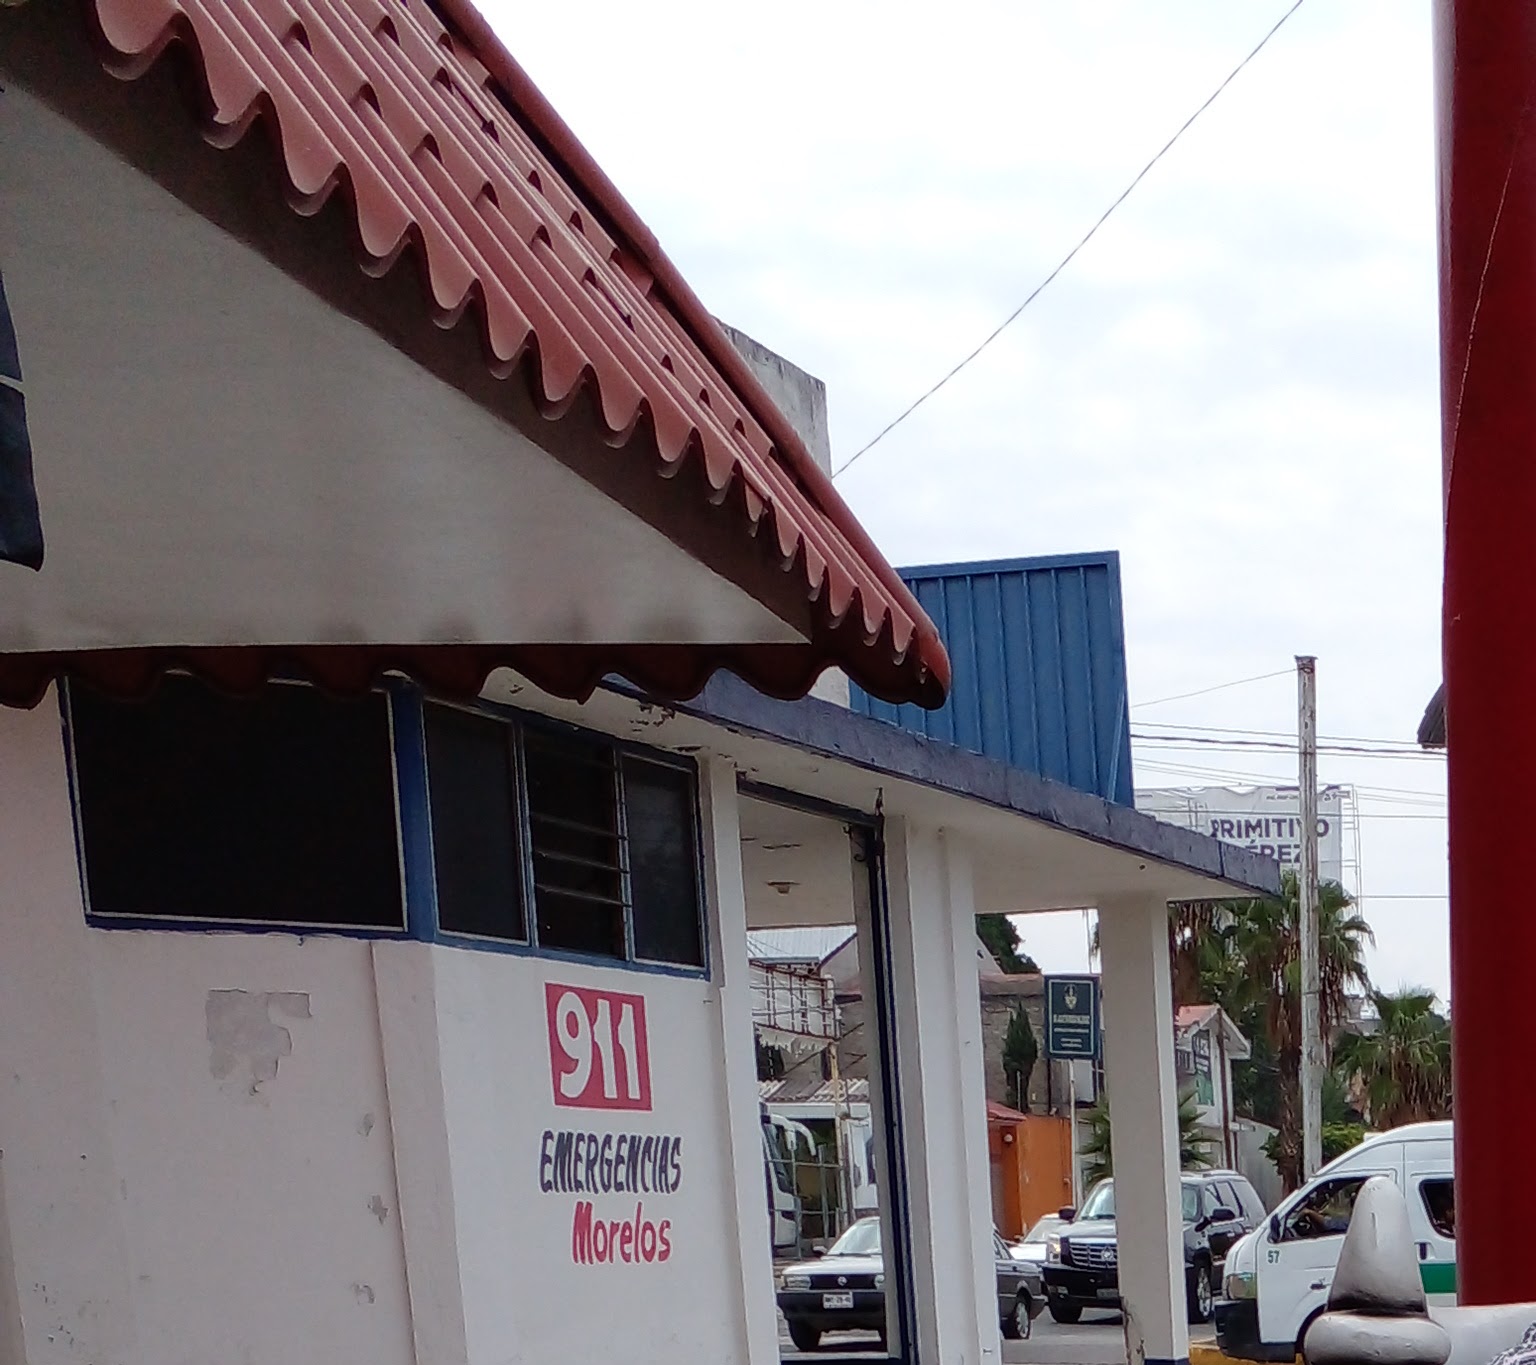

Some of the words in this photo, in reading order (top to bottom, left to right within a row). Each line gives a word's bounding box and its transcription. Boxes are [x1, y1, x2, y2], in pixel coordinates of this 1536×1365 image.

[556, 990, 641, 1100] 911
[539, 1129, 682, 1195] EMERGENCIAS
[571, 1200, 672, 1265] Morelos
[1267, 1250, 1280, 1264] 57
